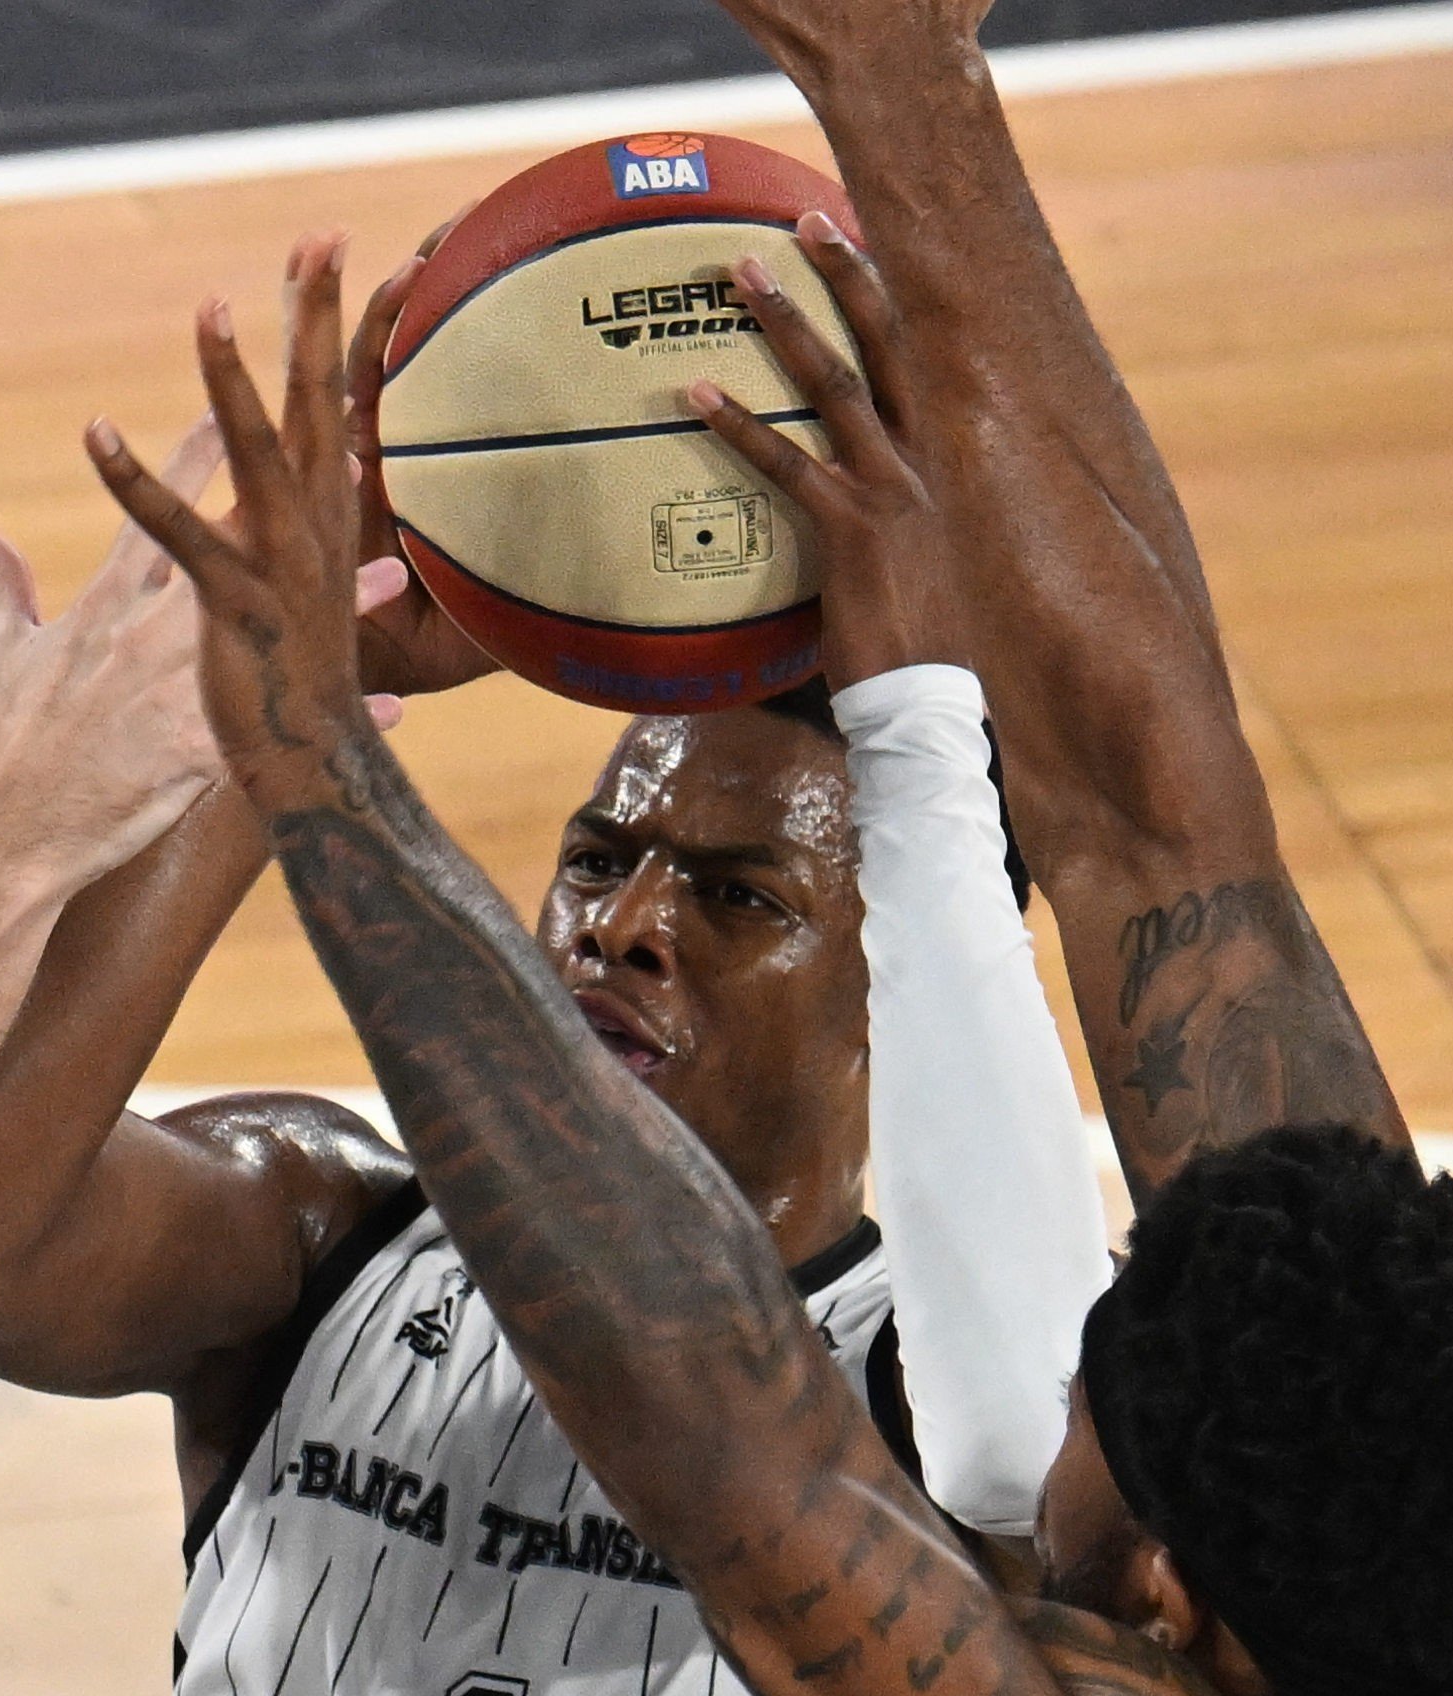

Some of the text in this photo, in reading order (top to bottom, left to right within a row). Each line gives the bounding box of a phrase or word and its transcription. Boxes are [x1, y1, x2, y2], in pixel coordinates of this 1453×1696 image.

[625, 159, 700, 192] ABA
[582, 281, 749, 326] LEGAC
[639, 338, 739, 357] OFFICIAL GAME BALL
[655, 520, 668, 548] SIZE
[742, 499, 760, 558] SPALDING
